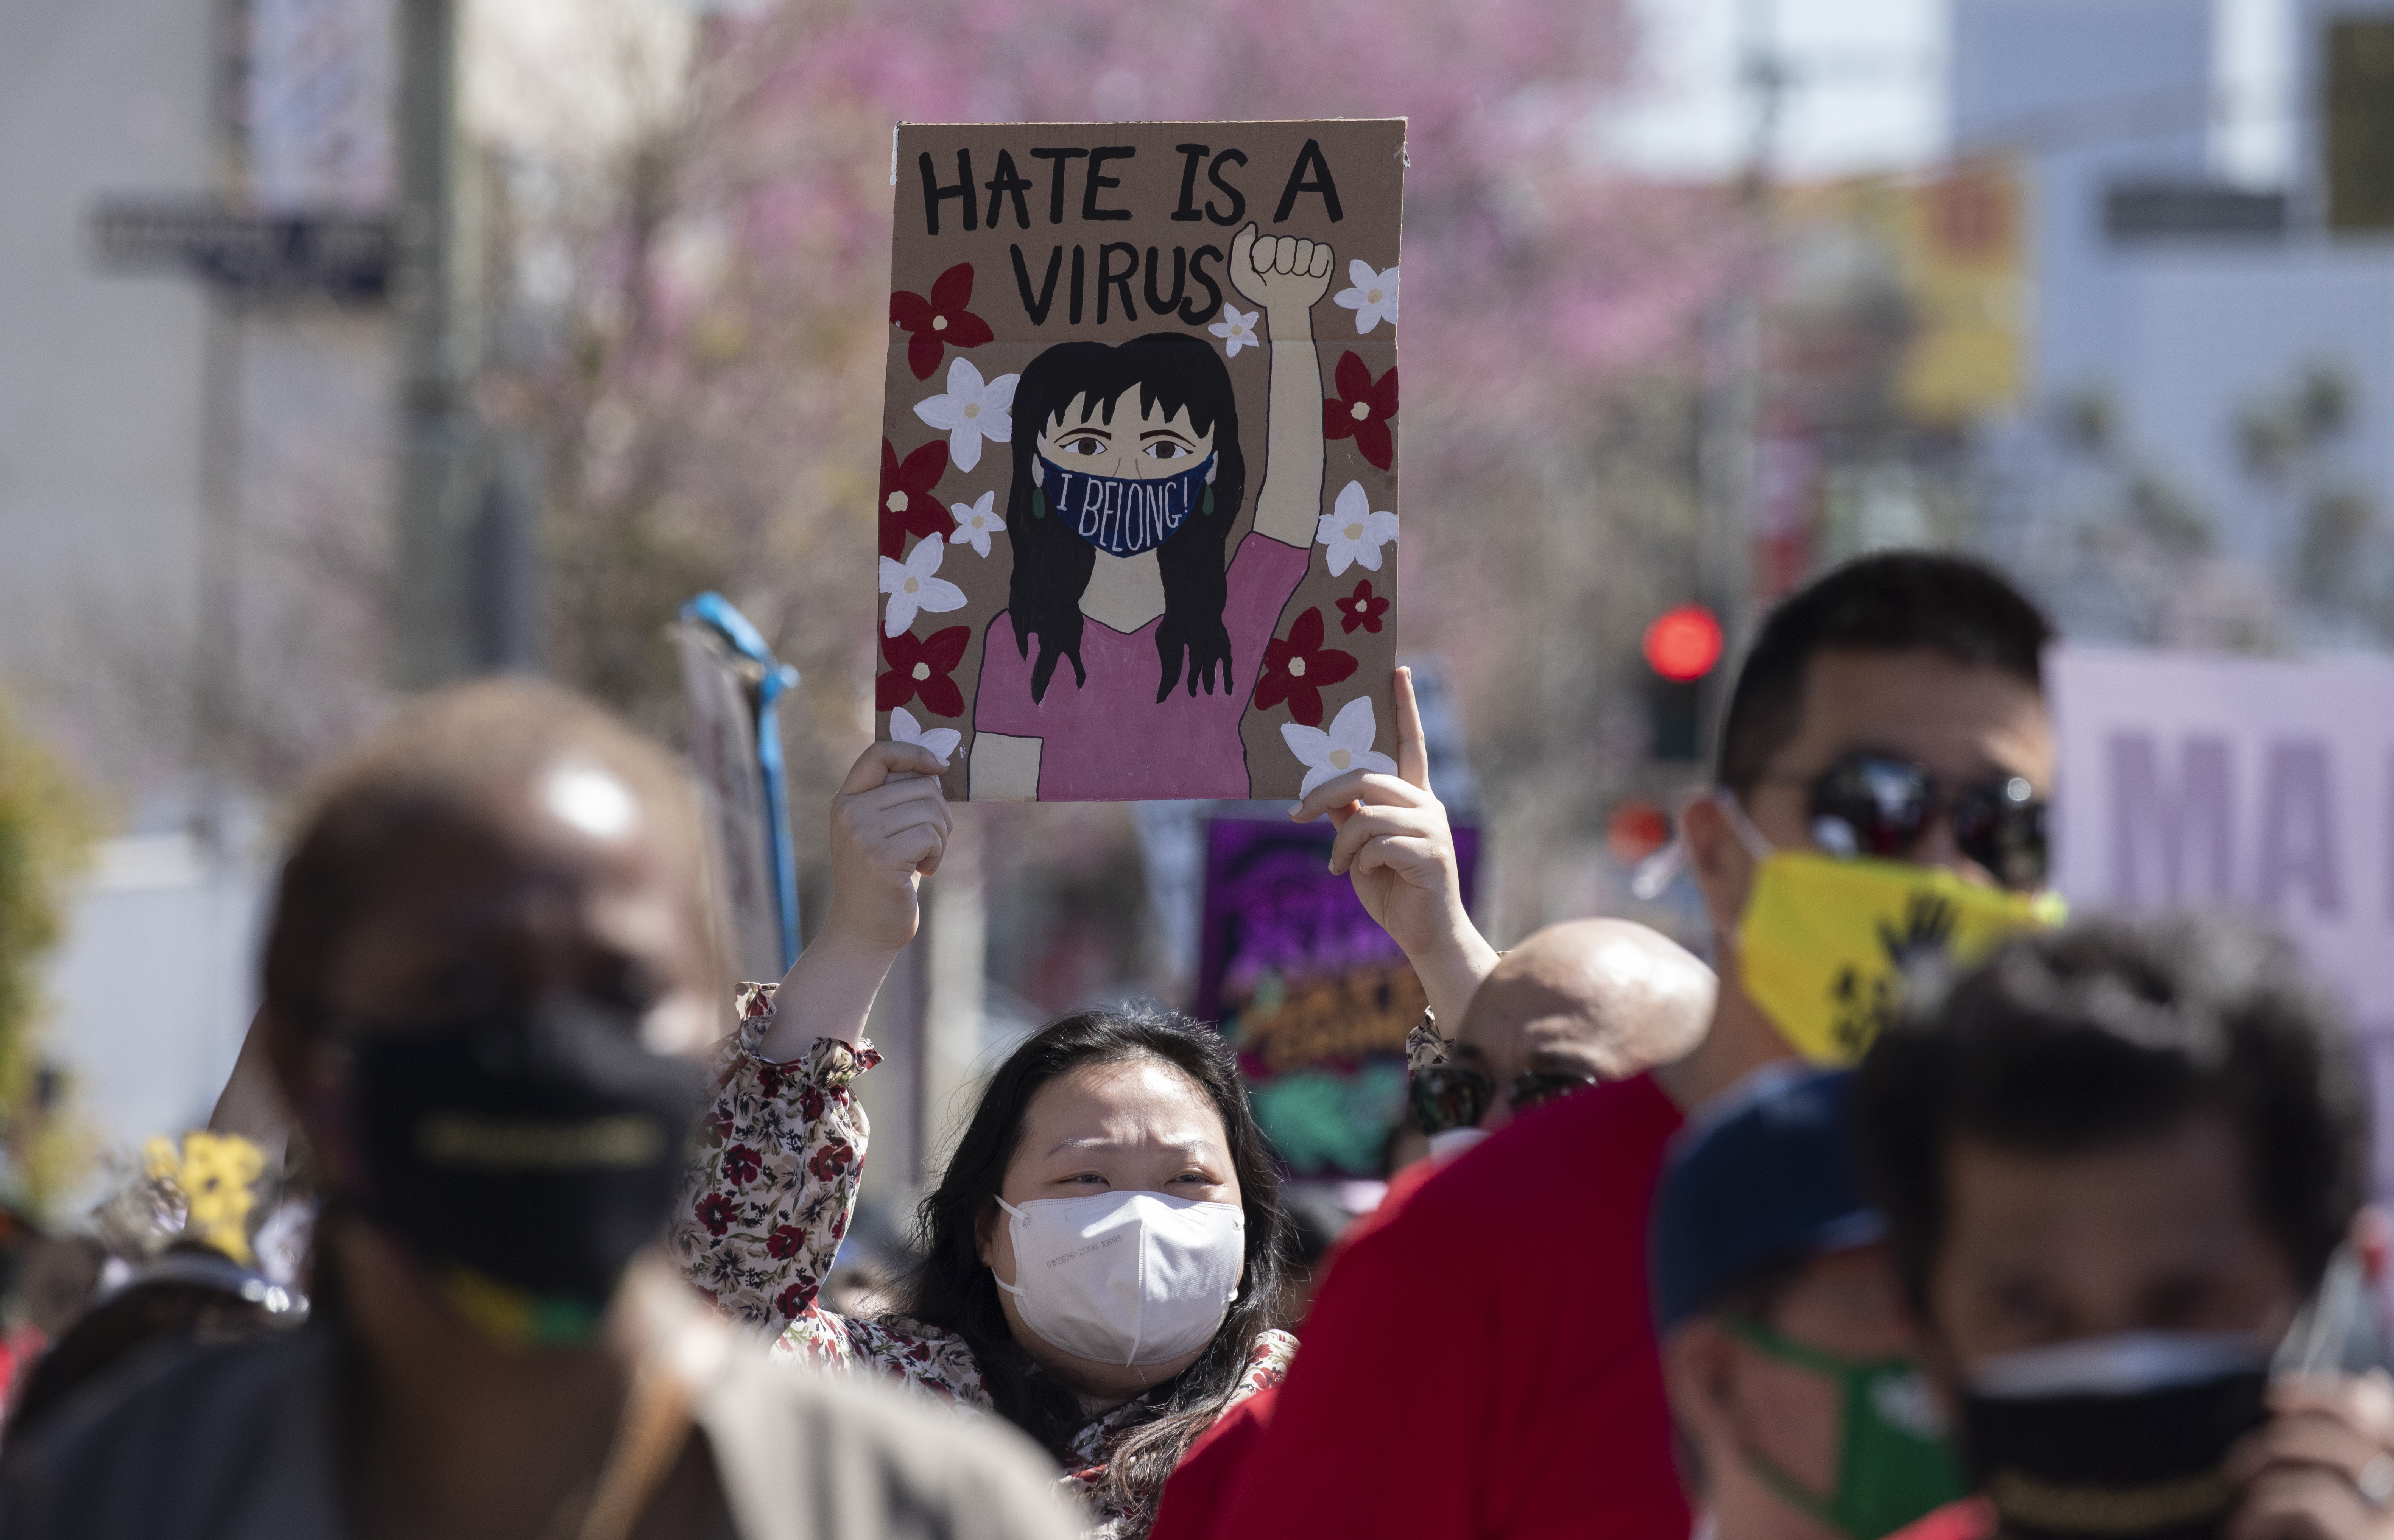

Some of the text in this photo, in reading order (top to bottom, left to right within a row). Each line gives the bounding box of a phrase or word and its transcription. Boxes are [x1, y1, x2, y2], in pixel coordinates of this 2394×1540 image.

[919, 138, 1344, 235] HATE IS A
[1009, 241, 1225, 327] VIRUS
[1056, 473, 1188, 552] I BELONG!
[2106, 725, 2394, 920] MA
[1047, 1235, 1122, 1268] GB2626-2006 KN95
